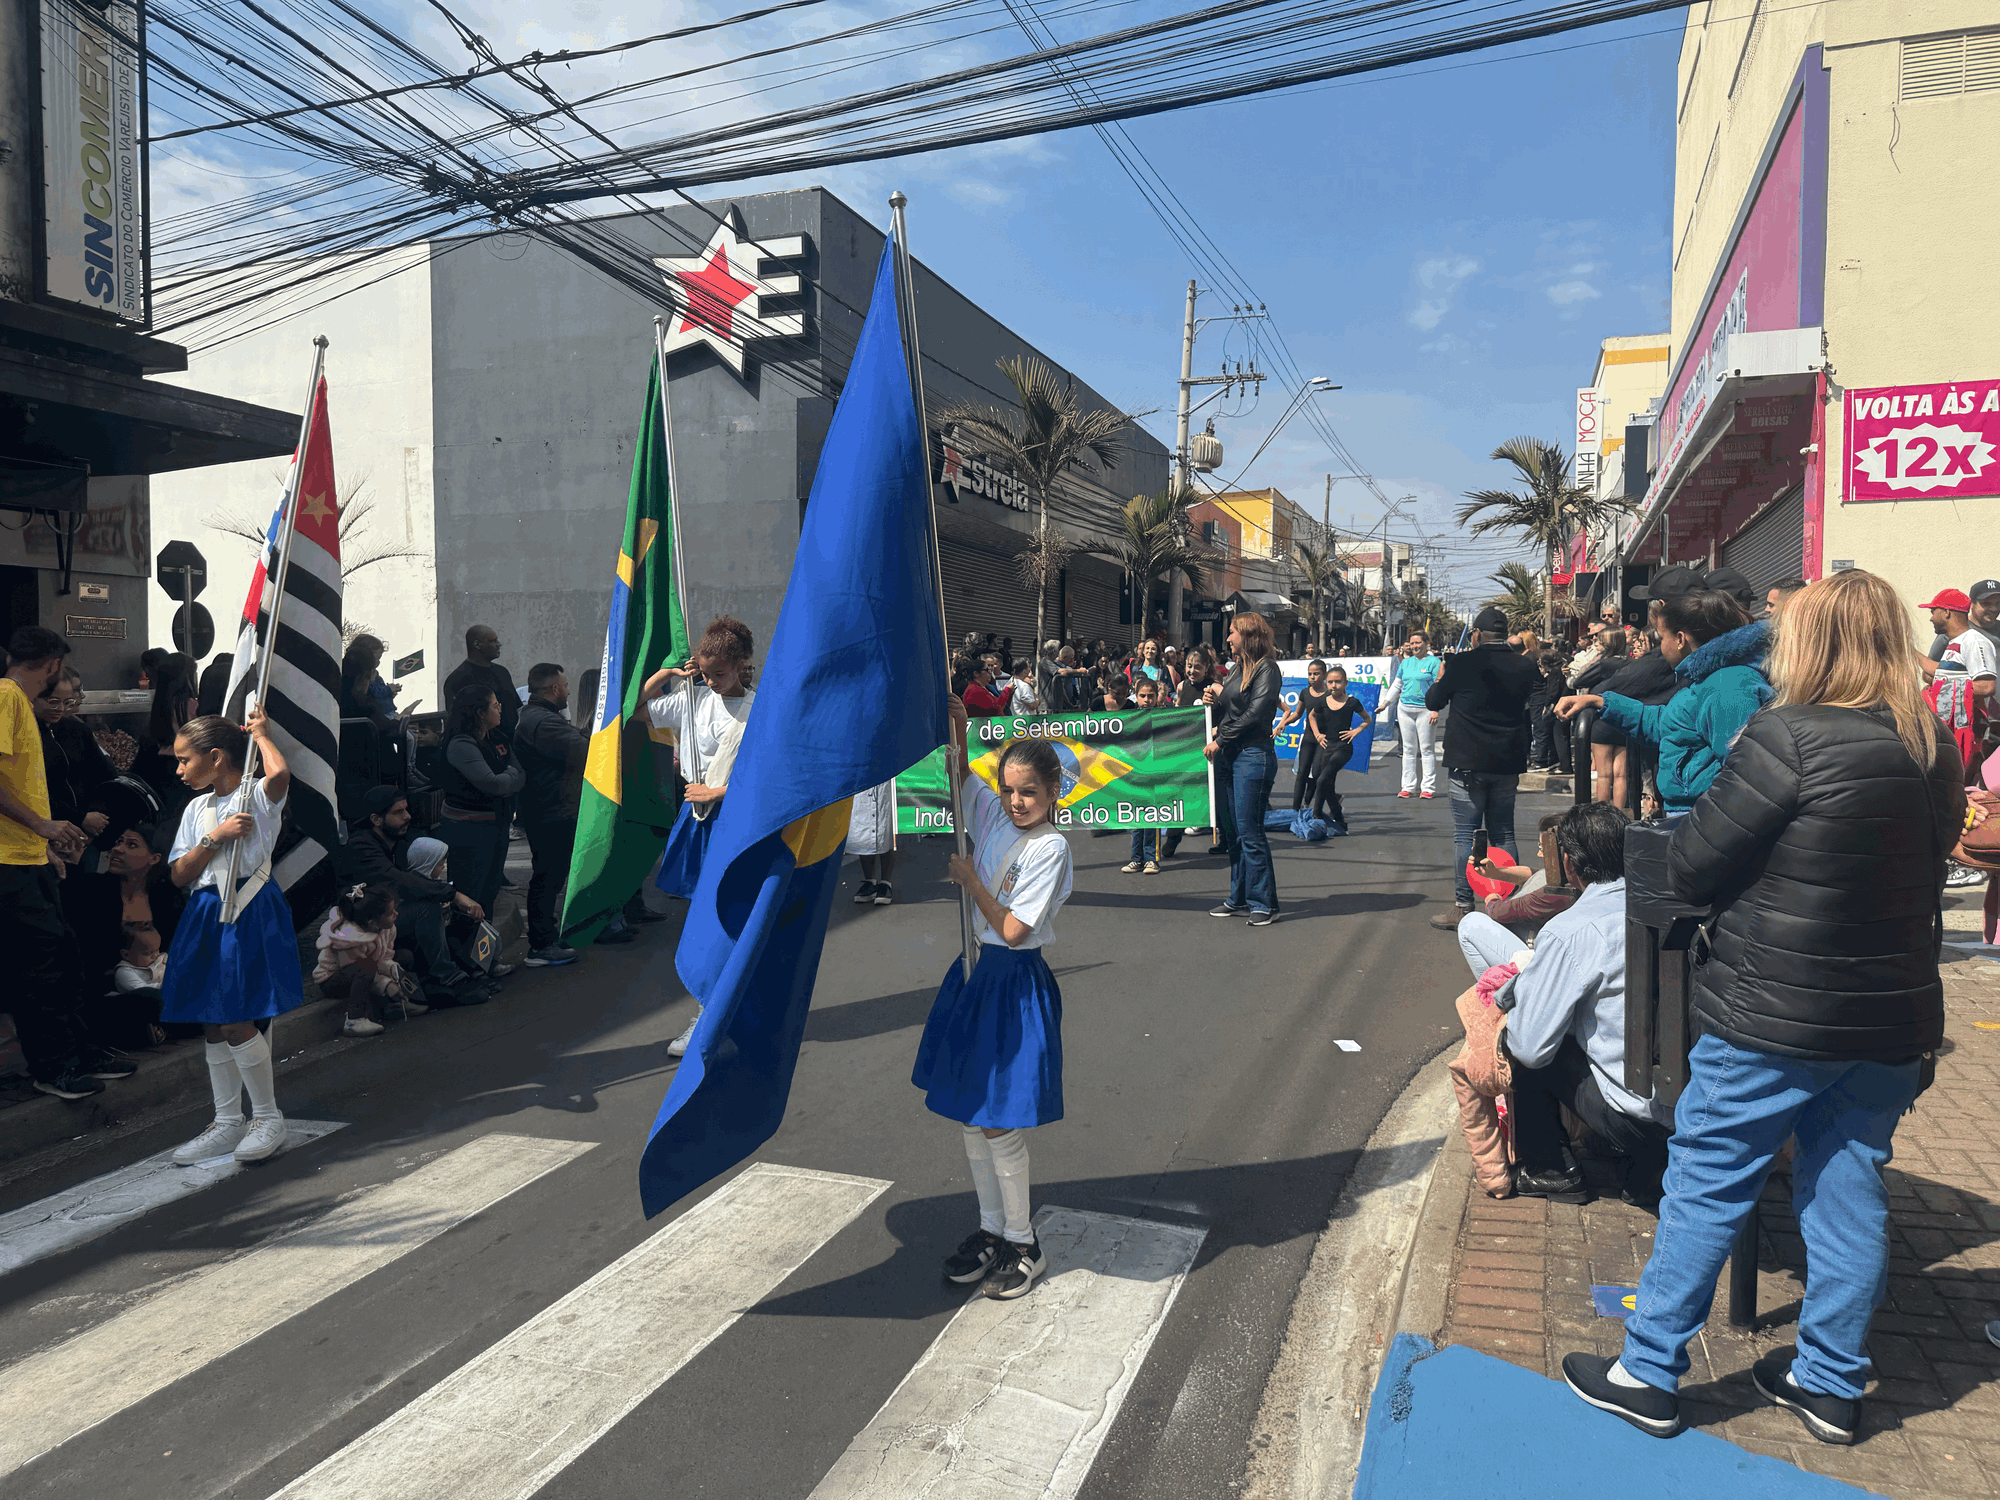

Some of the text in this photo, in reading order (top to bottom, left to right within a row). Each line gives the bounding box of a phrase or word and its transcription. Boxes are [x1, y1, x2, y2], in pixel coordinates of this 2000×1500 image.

[119, 66, 129, 85] DE
[118, 88, 131, 151] VAREJISTA
[119, 155, 133, 222] COMÉRCIO
[122, 224, 133, 242] DO
[122, 244, 135, 310] SINDICATO
[1578, 392, 1596, 442] MOÇA
[1855, 394, 1934, 420] VOLTA
[1940, 386, 1976, 415] ÀS
[1751, 415, 1789, 427] BOLSAS
[1873, 436, 1978, 479] 12x
[1354, 663, 1374, 676] 30
[979, 720, 1005, 741] de
[1012, 714, 1123, 739] Setembro
[1080, 802, 1110, 824] do
[1117, 800, 1184, 823] Brasil
